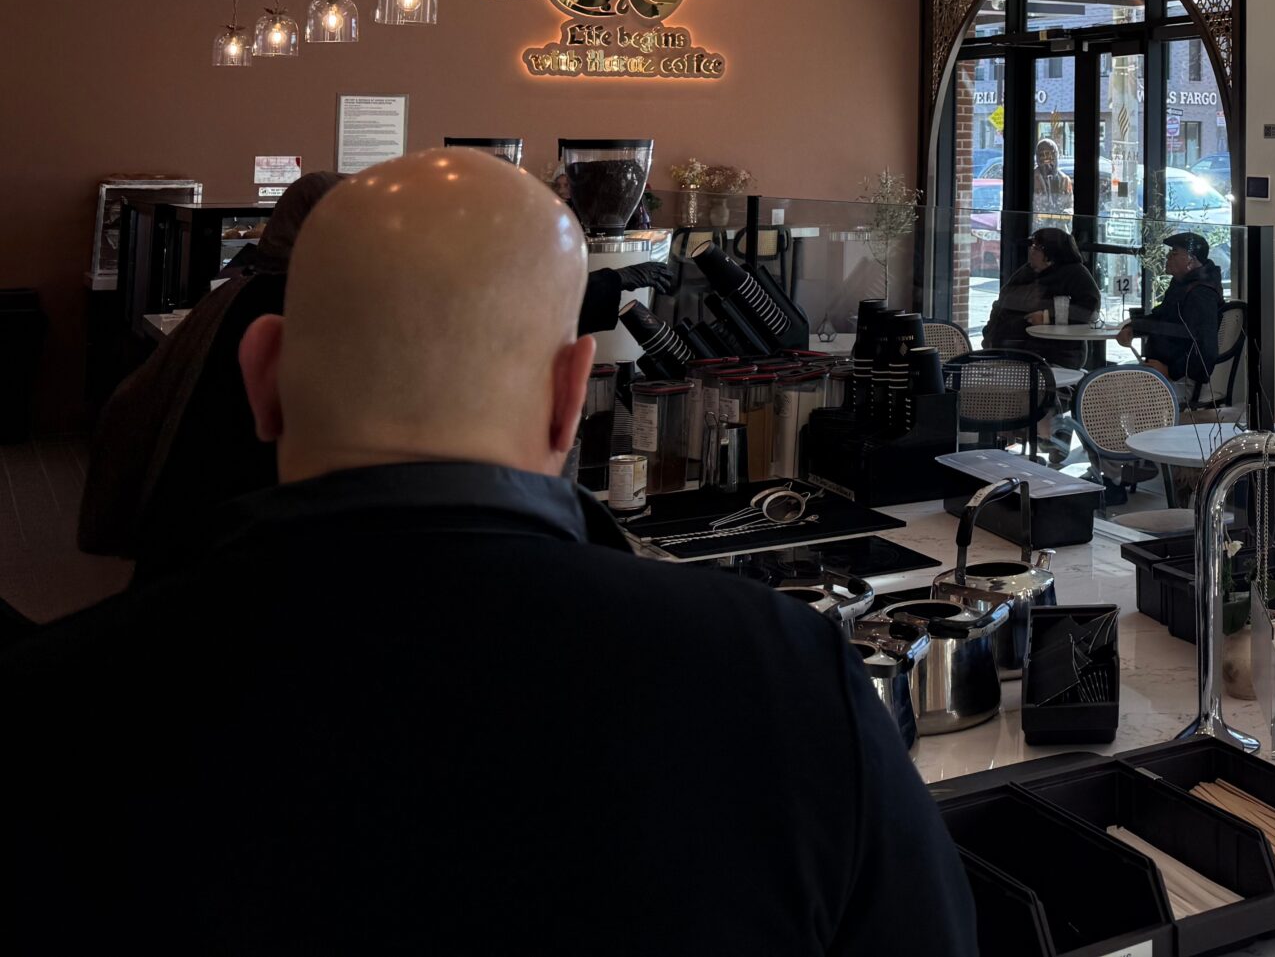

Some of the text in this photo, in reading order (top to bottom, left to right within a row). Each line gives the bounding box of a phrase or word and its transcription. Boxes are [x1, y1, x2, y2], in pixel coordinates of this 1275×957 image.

[567, 24, 688, 53] Life begins
[529, 50, 723, 74] with Haraz coffee
[1180, 92, 1217, 105] FARGO
[1116, 278, 1130, 292] 12
